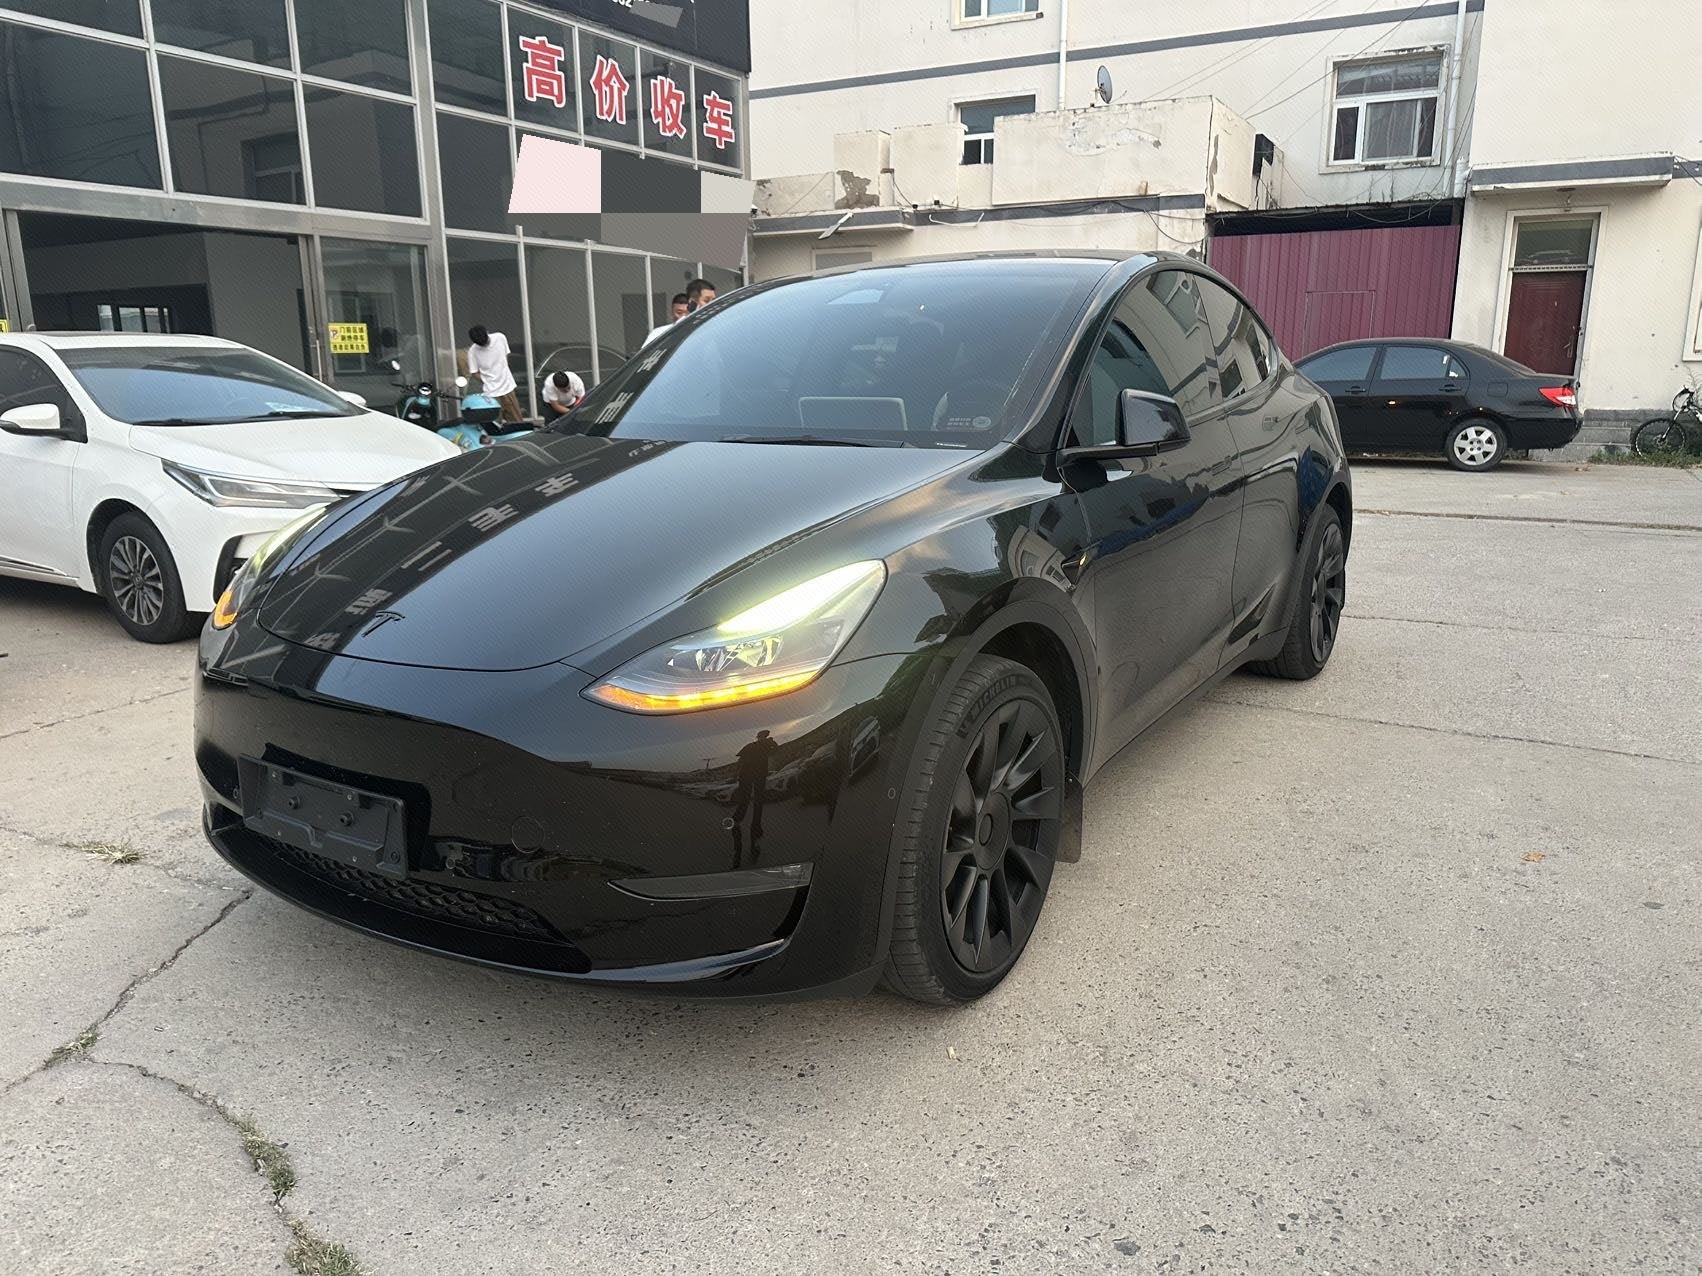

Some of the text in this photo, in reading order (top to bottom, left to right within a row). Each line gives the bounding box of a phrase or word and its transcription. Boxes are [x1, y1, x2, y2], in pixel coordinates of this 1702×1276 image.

[519, 35, 735, 149] 高价收车
[970, 674, 1018, 723] MICHELIN
